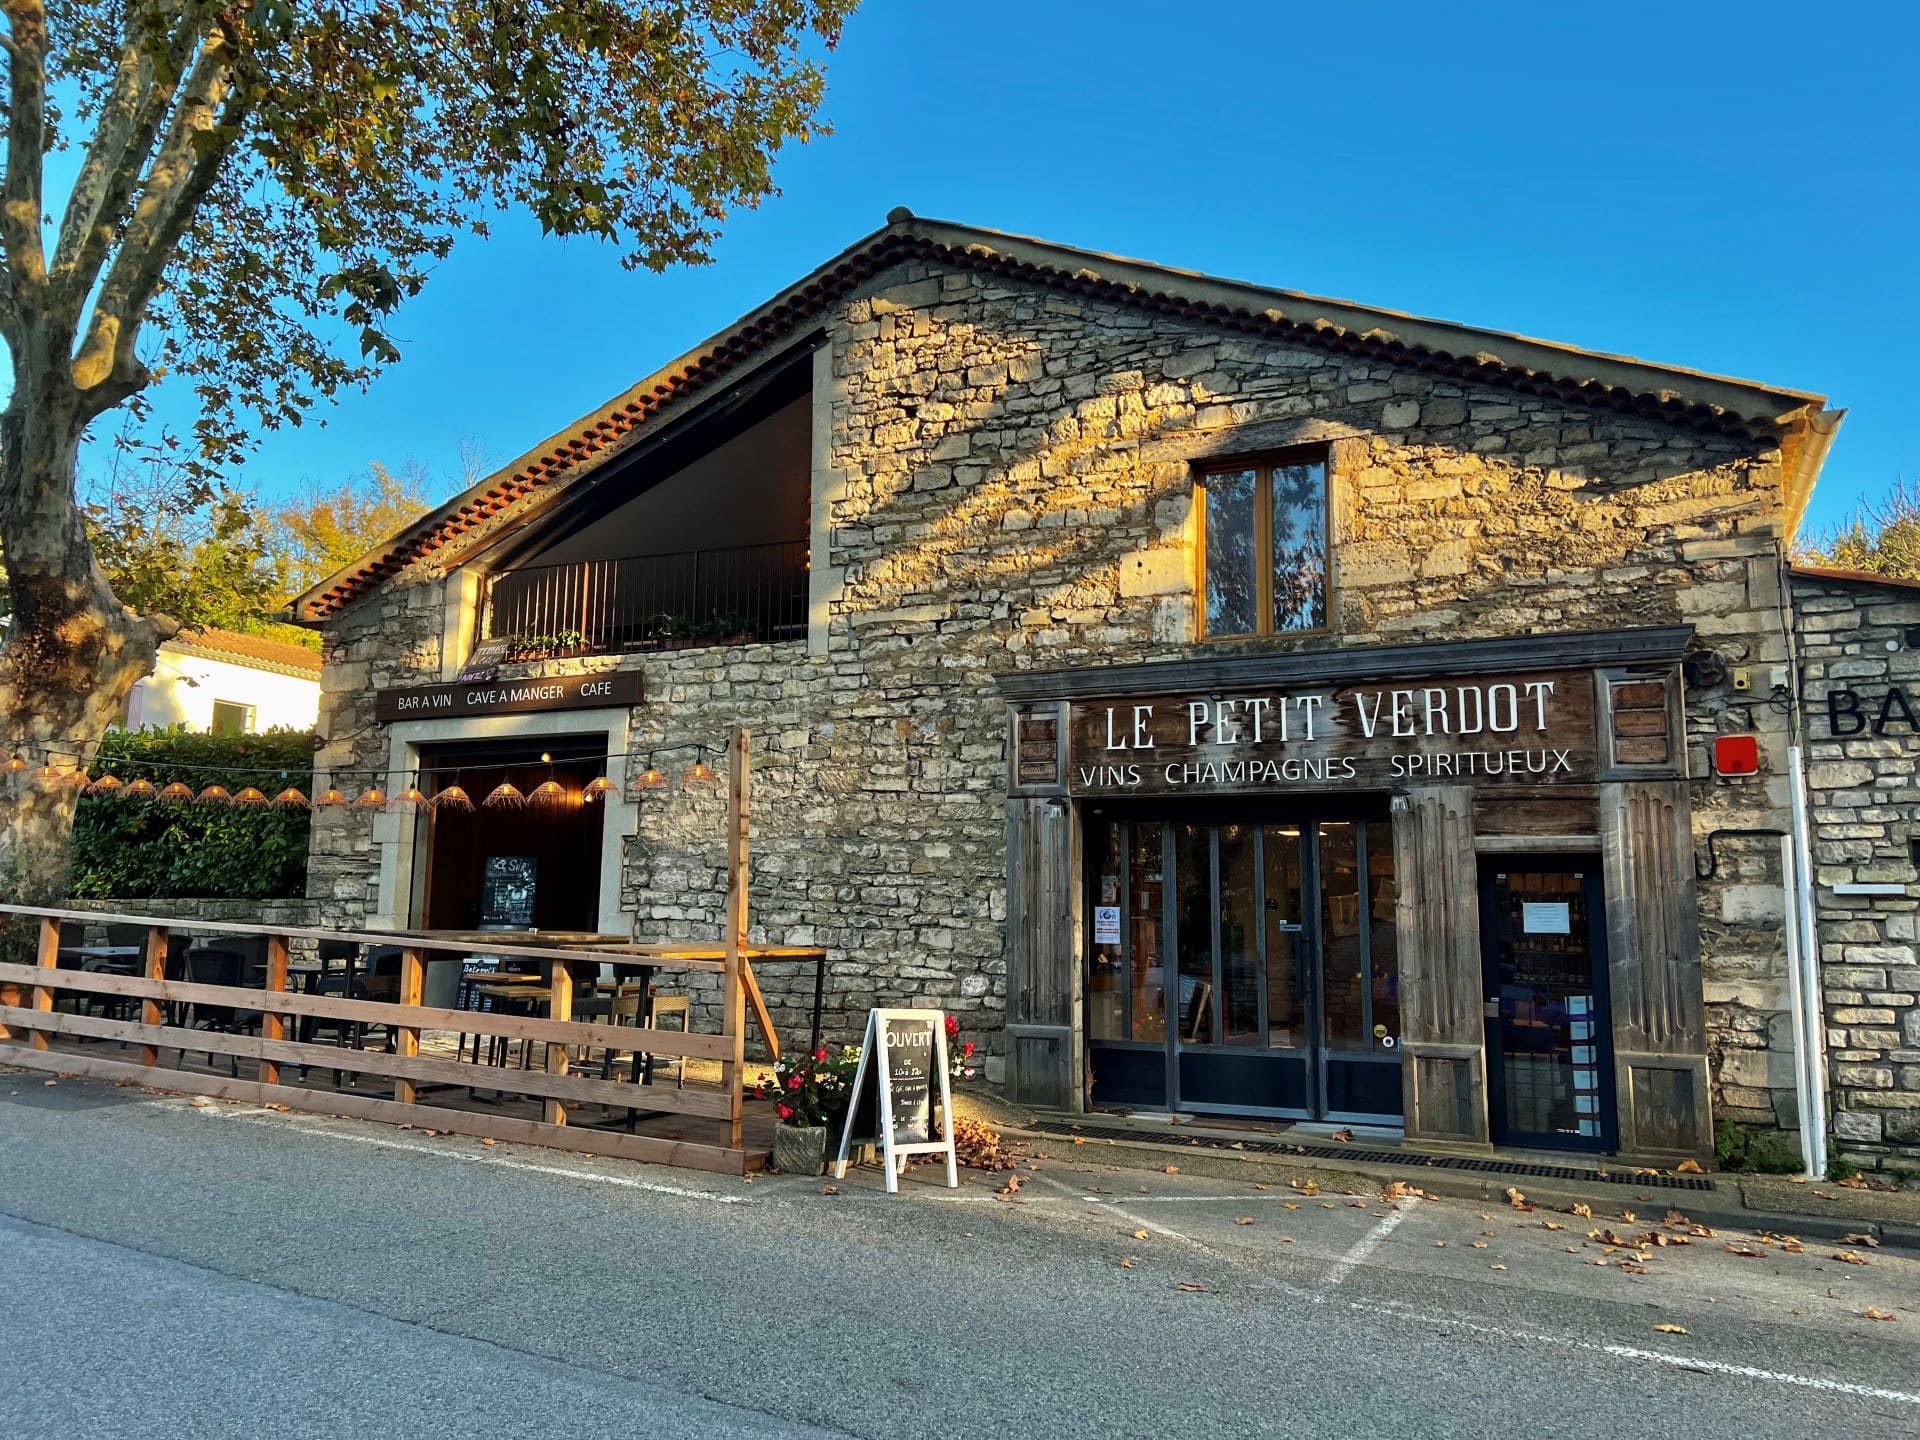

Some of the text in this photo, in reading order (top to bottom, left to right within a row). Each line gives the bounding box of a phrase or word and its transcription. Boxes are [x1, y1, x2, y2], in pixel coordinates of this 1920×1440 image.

[398, 681, 612, 710] BAR A VIN CAVE A MANGER CAFE
[1827, 687, 1920, 737] BA
[1106, 681, 1555, 750] LE PETIT VERDOT
[1080, 749, 1571, 786] VINS CHAMPAGNES SPIRITUEUX
[887, 1031, 932, 1048] OUVERT
